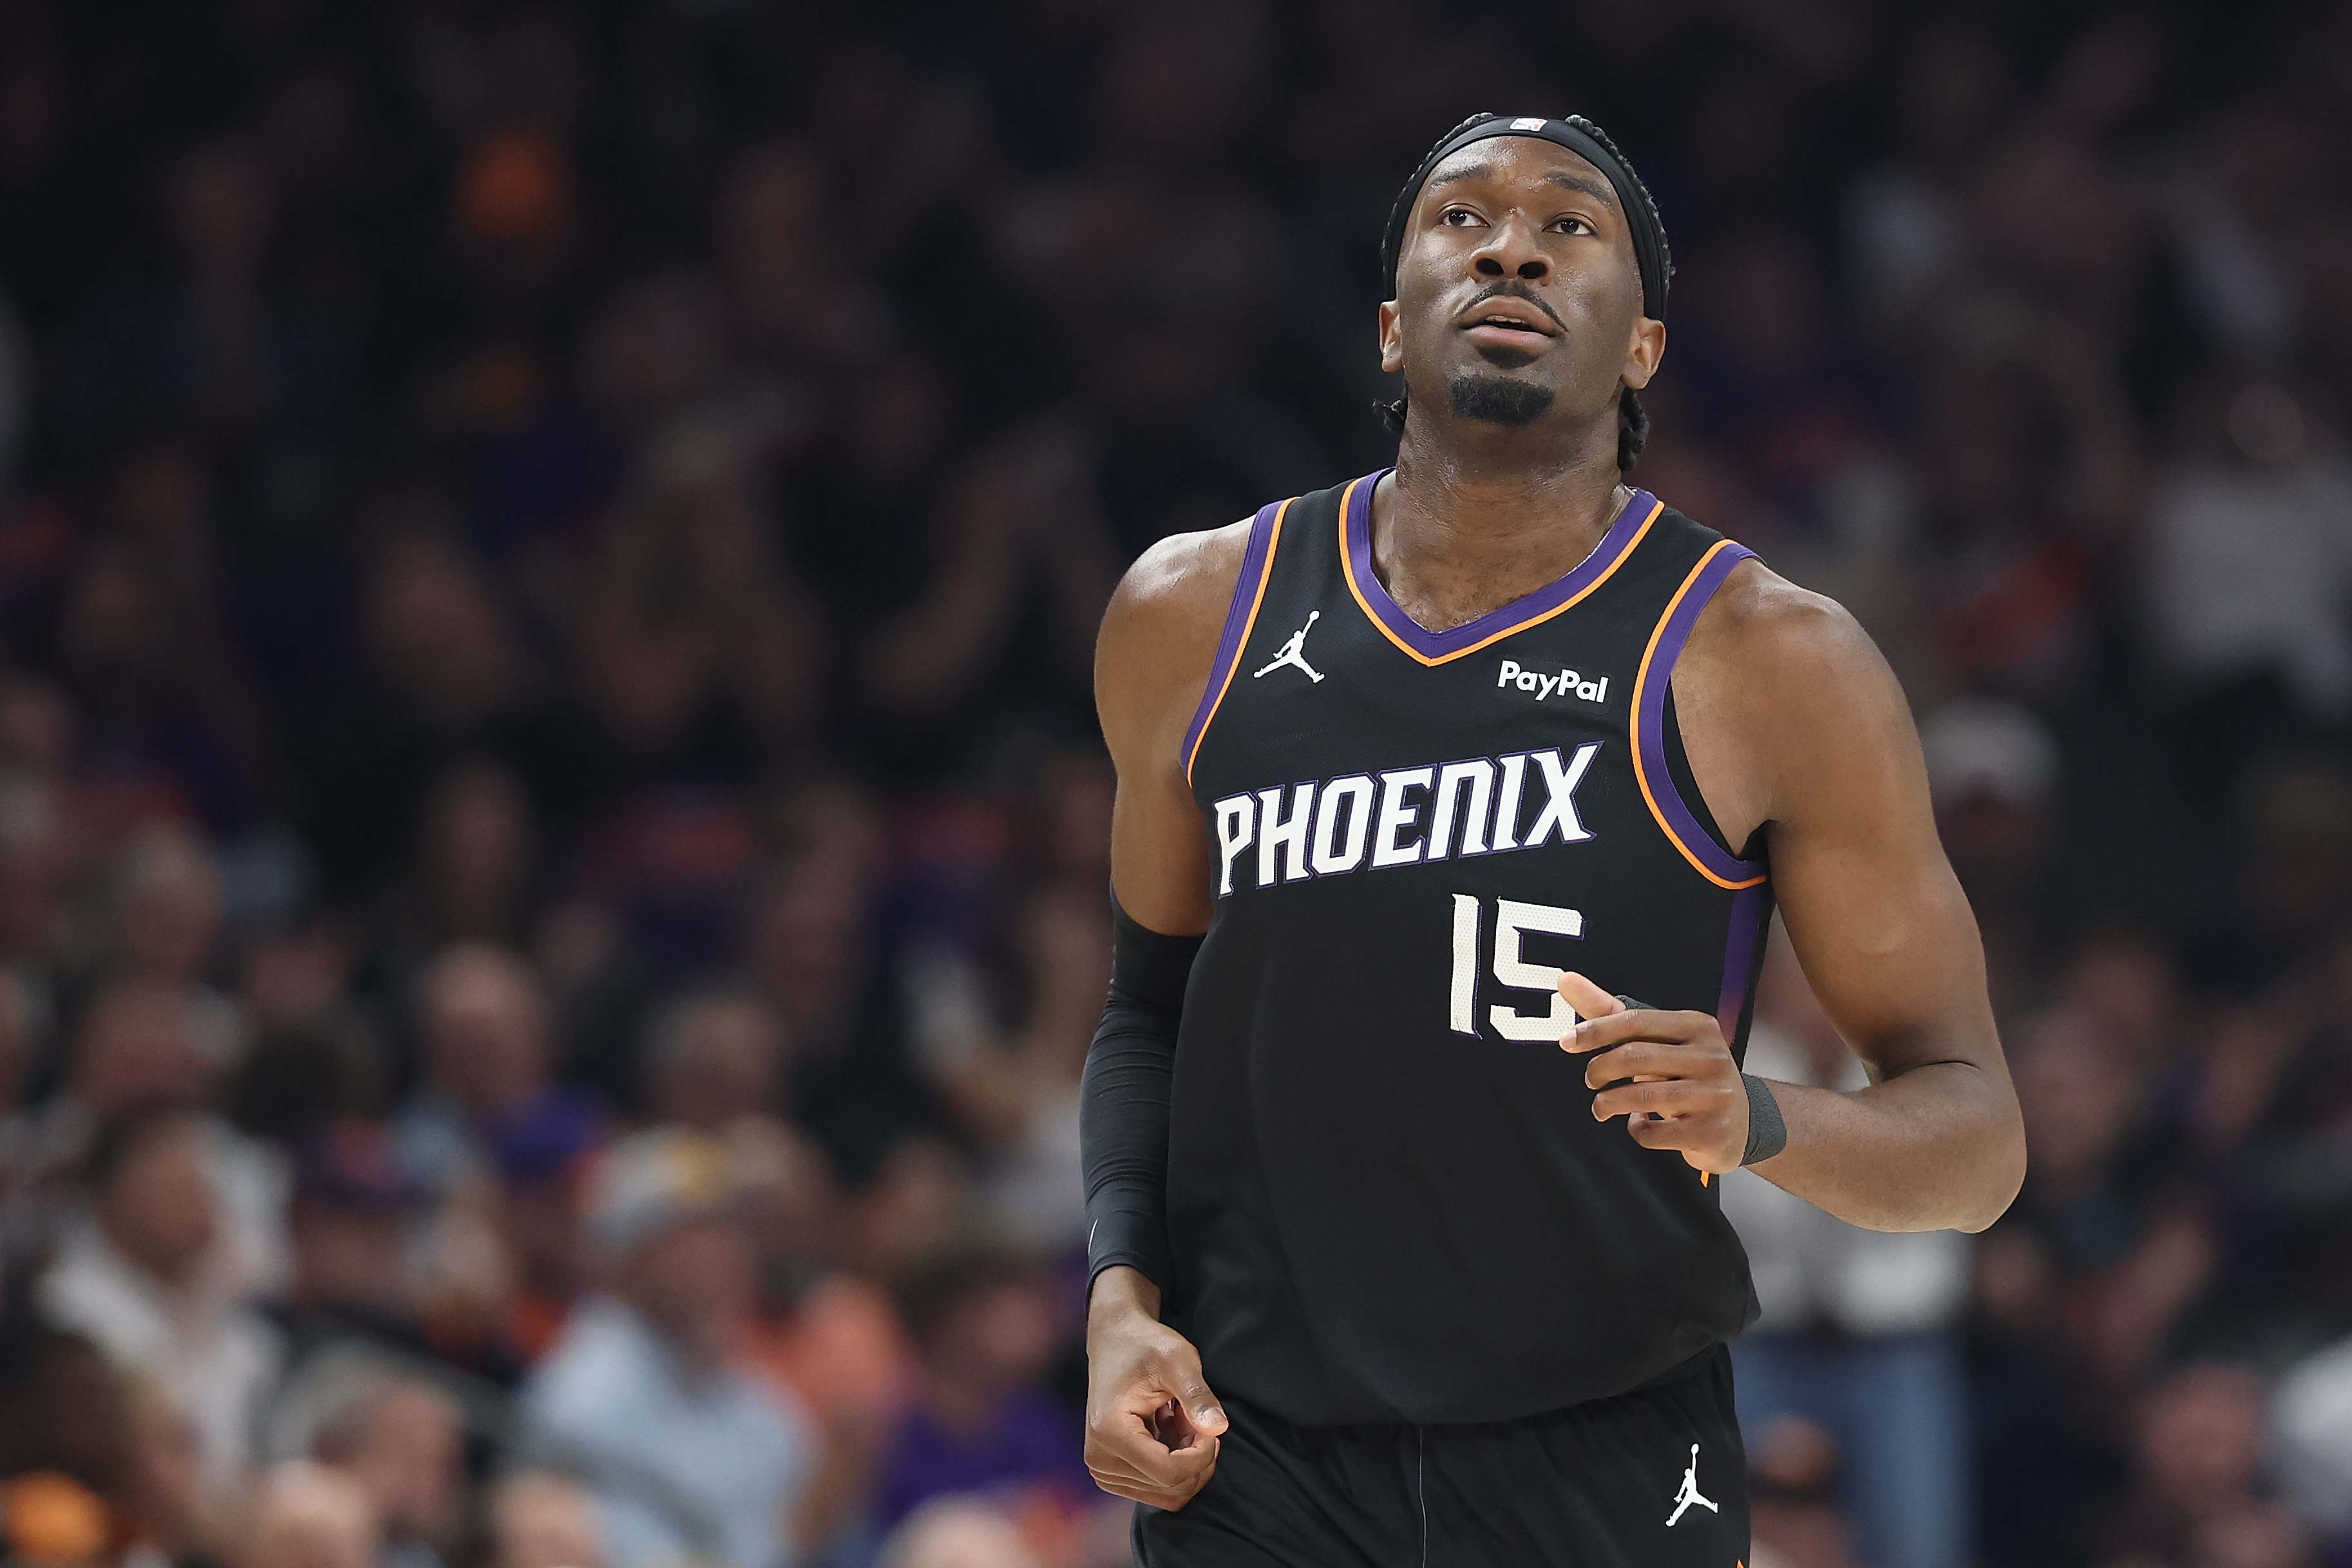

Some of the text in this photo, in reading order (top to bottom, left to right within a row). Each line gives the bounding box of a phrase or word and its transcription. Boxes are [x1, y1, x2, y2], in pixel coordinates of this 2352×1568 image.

[1497, 660, 1609, 703] PayPal
[1213, 741, 1604, 899] PHOENIX
[1450, 893, 1586, 1043] 15
